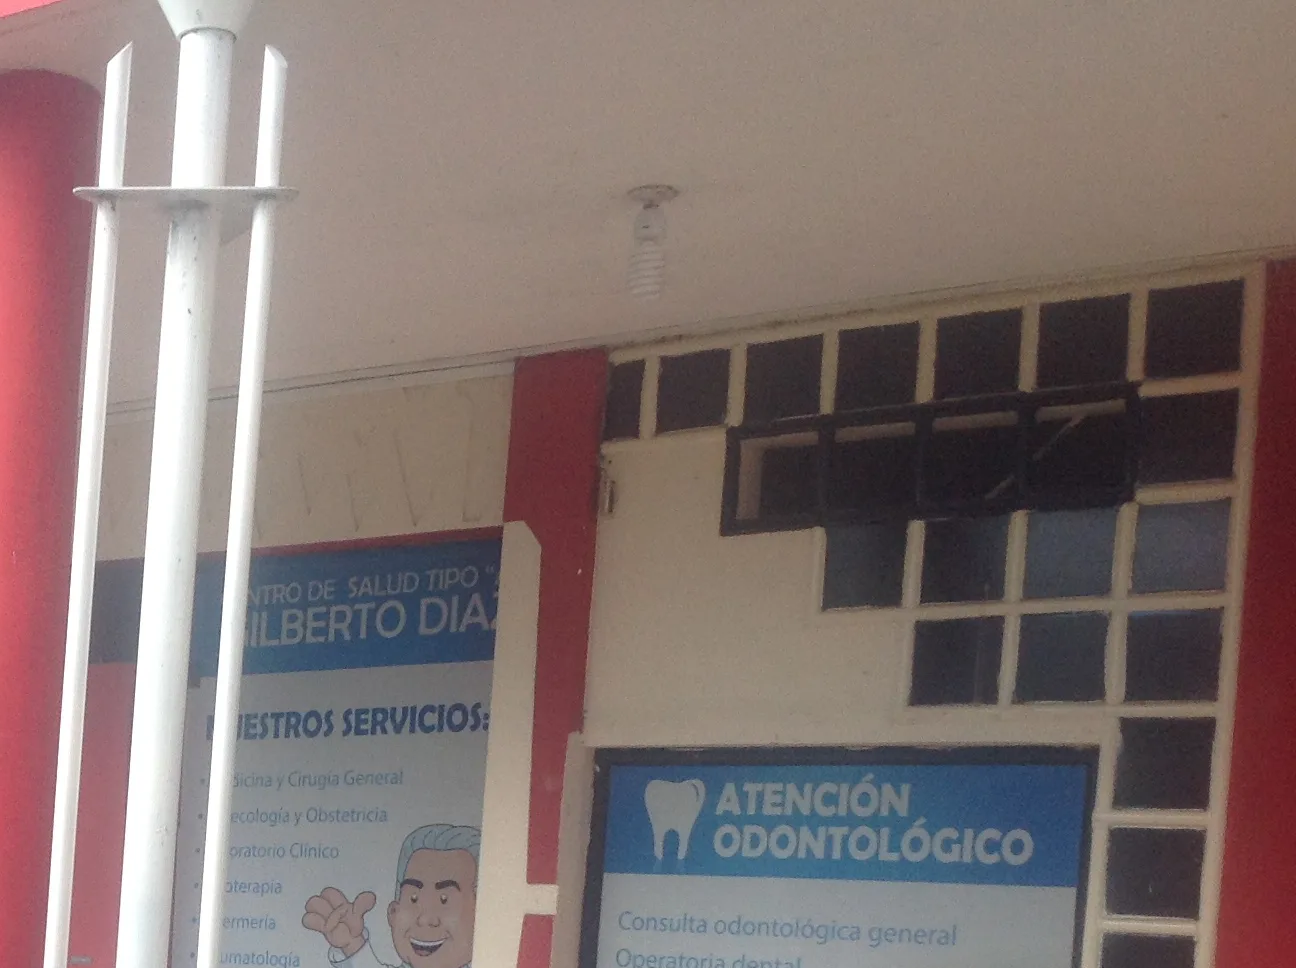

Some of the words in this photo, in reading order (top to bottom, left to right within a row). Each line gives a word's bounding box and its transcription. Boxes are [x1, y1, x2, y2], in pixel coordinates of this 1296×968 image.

[248, 581, 302, 605] NTRO
[308, 579, 337, 601] DE
[348, 571, 420, 598] SALUD
[426, 565, 479, 592] TIPO
[245, 599, 406, 647] ILBERTO
[418, 592, 497, 636] DIA
[342, 702, 489, 738] SERVICIOS:
[233, 770, 272, 788] dicina
[277, 774, 285, 791] y
[343, 768, 403, 787] General
[716, 773, 911, 817] ATENCIÓN
[231, 806, 290, 827] ecología
[294, 811, 303, 826] y
[306, 806, 388, 823] Obstetricia
[229, 844, 286, 859] oratorio
[713, 816, 1034, 866] ODONTOLÓGICO
[225, 879, 283, 897] oterapia
[222, 914, 276, 931] ermería
[618, 911, 708, 934] Consulta
[714, 915, 861, 945] odontológica
[868, 924, 958, 948] general
